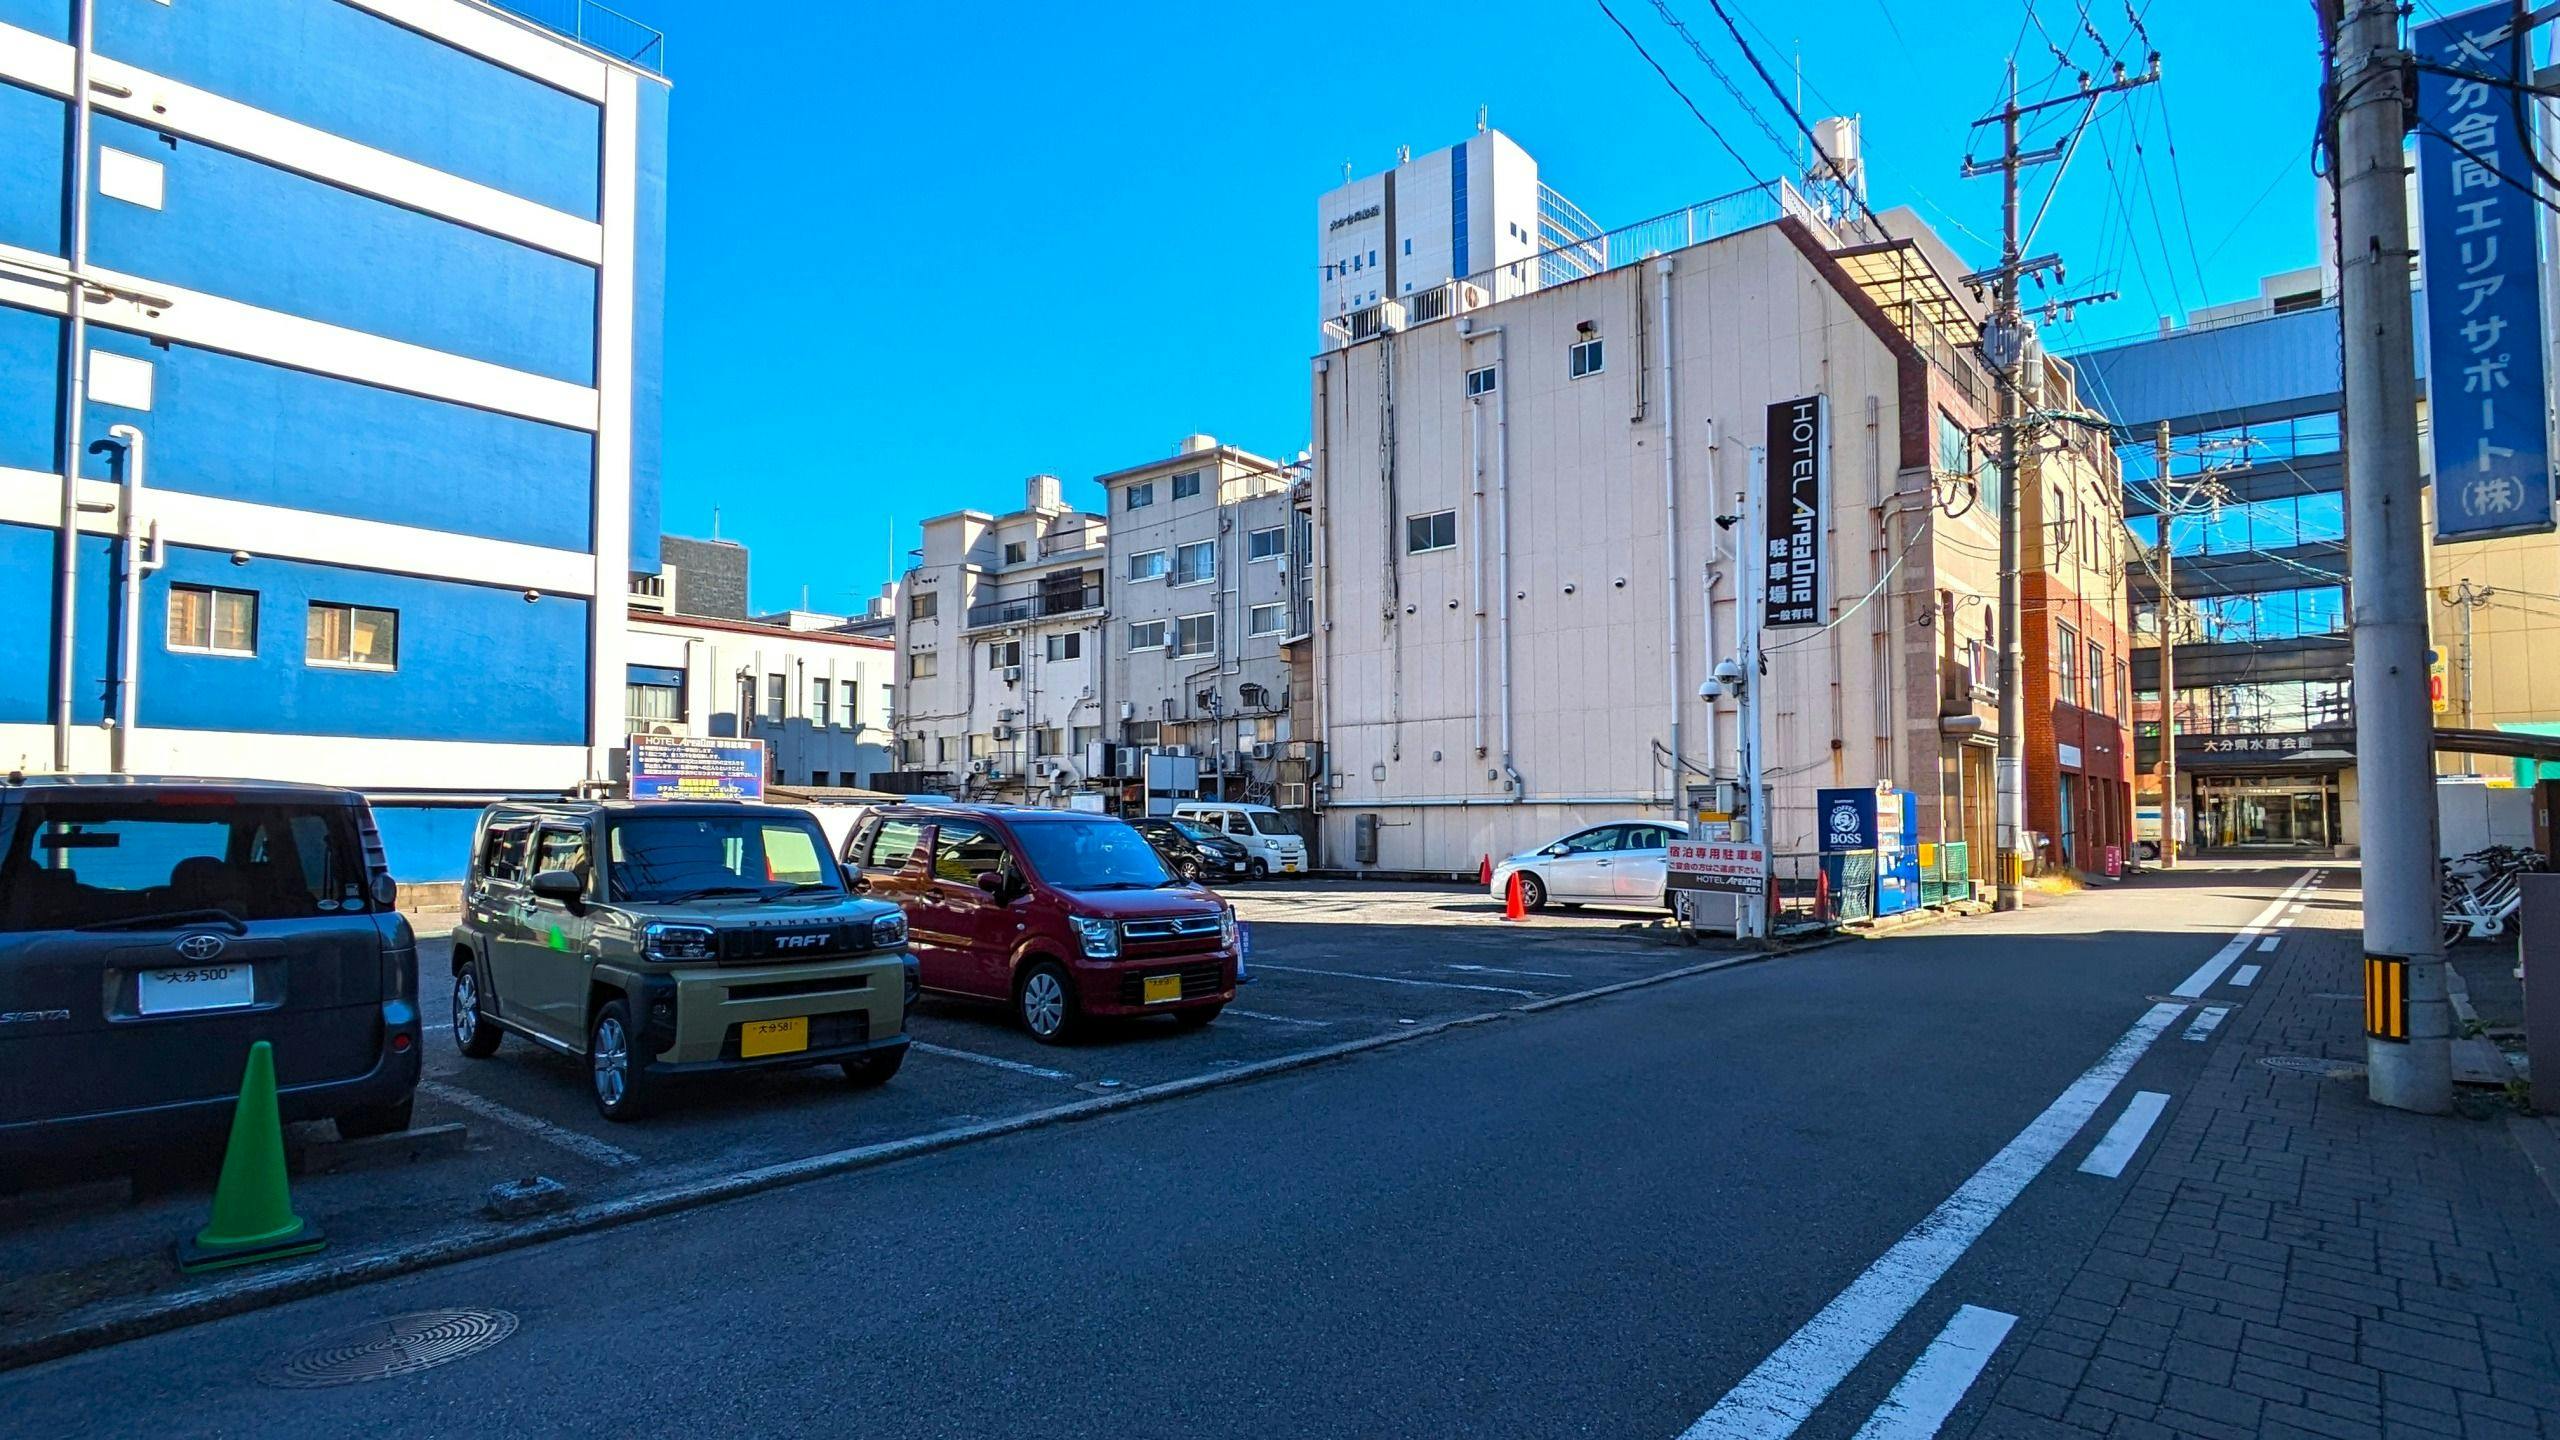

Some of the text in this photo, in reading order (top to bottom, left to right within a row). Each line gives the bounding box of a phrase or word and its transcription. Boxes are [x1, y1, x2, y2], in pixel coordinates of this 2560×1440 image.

[1791, 403, 1816, 603] HOTEL AreaOne
[1769, 538, 1788, 604] 駐車場
[1768, 607, 1814, 621] 一般有料
[645, 736, 679, 746] HOTEL
[2203, 736, 2313, 752] 大分県水産会館
[1830, 833, 1862, 844] BOSS
[1669, 846, 1763, 862] 宿泊専用駐車場
[1696, 875, 1762, 887] HOTEL AreaOne
[775, 933, 831, 948] TAFT
[167, 968, 228, 984] 大分 500
[758, 1023, 777, 1034] 大分
